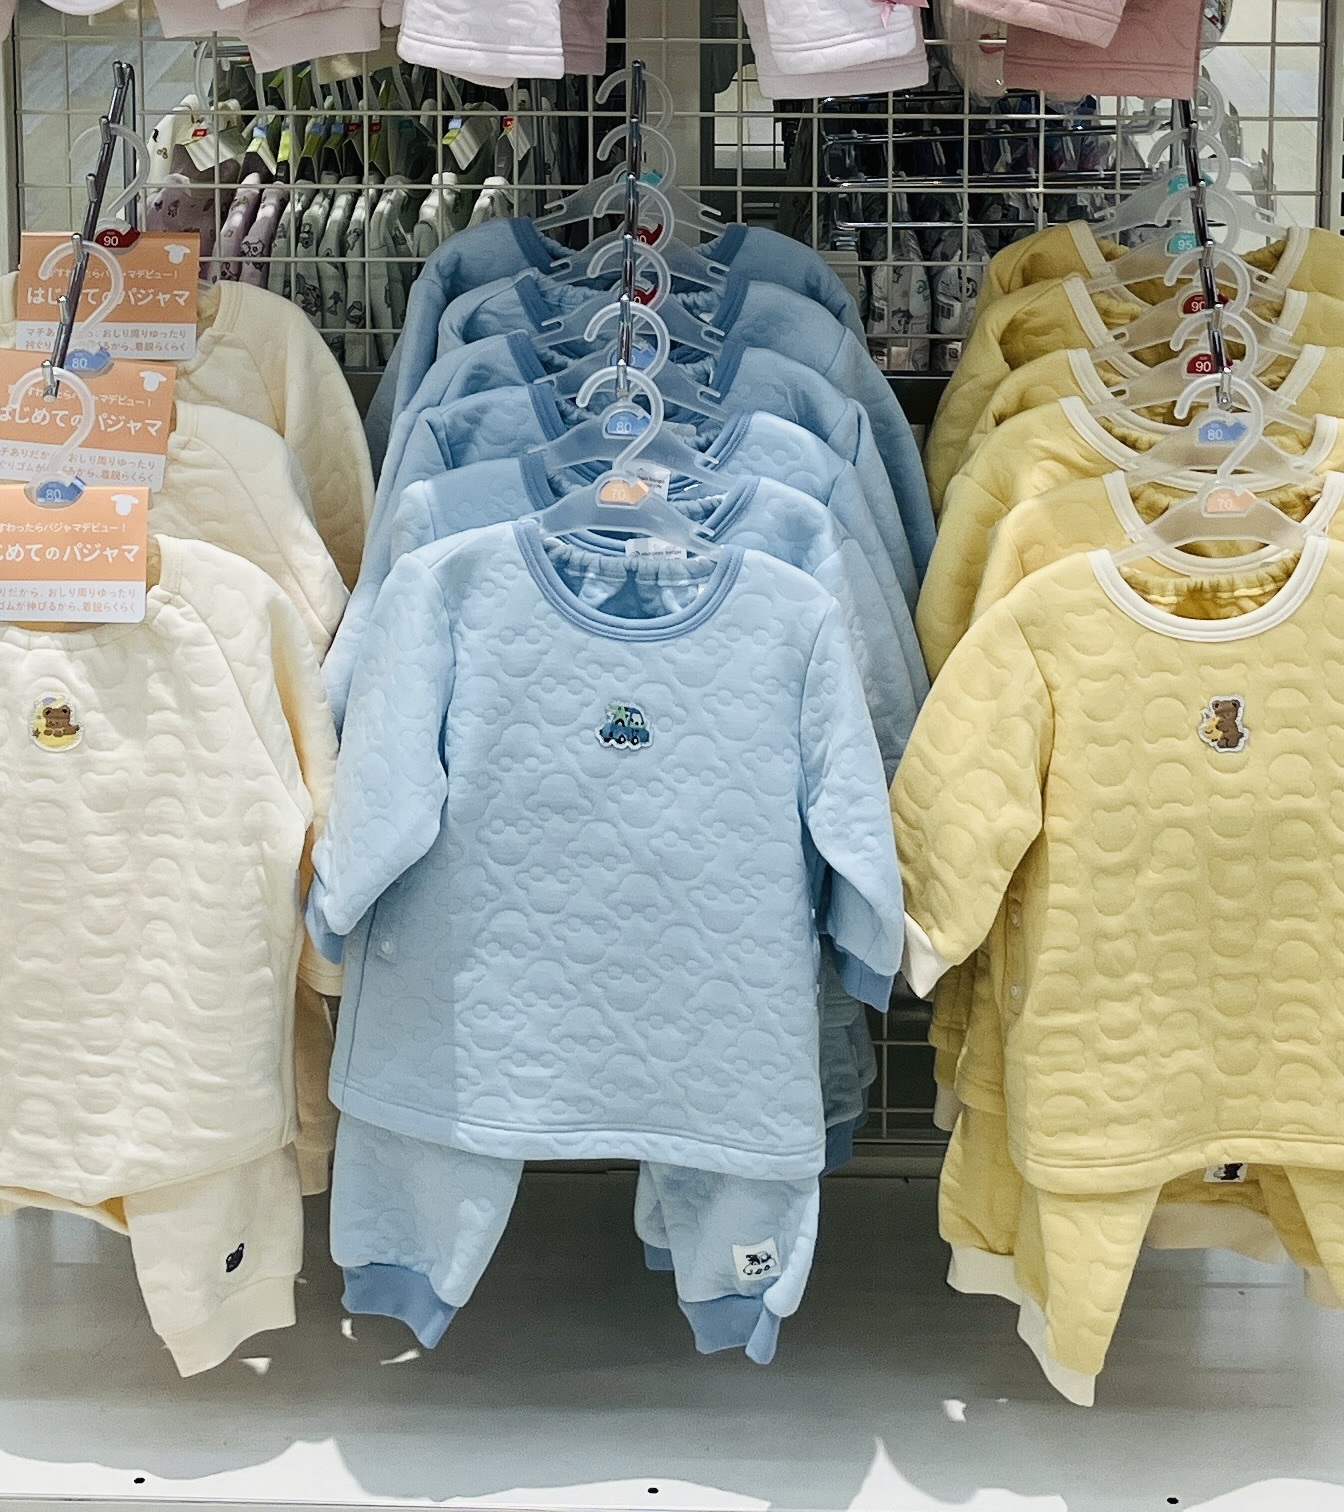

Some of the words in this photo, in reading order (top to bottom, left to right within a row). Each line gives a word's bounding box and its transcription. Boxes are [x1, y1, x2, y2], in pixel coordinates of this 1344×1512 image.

[103, 236, 119, 247] 90
[1178, 240, 1193, 251] 95
[71, 357, 88, 369] 80
[1195, 361, 1211, 372] 90
[616, 422, 632, 433] 80
[1207, 429, 1223, 440] 80
[46, 489, 62, 500] 80
